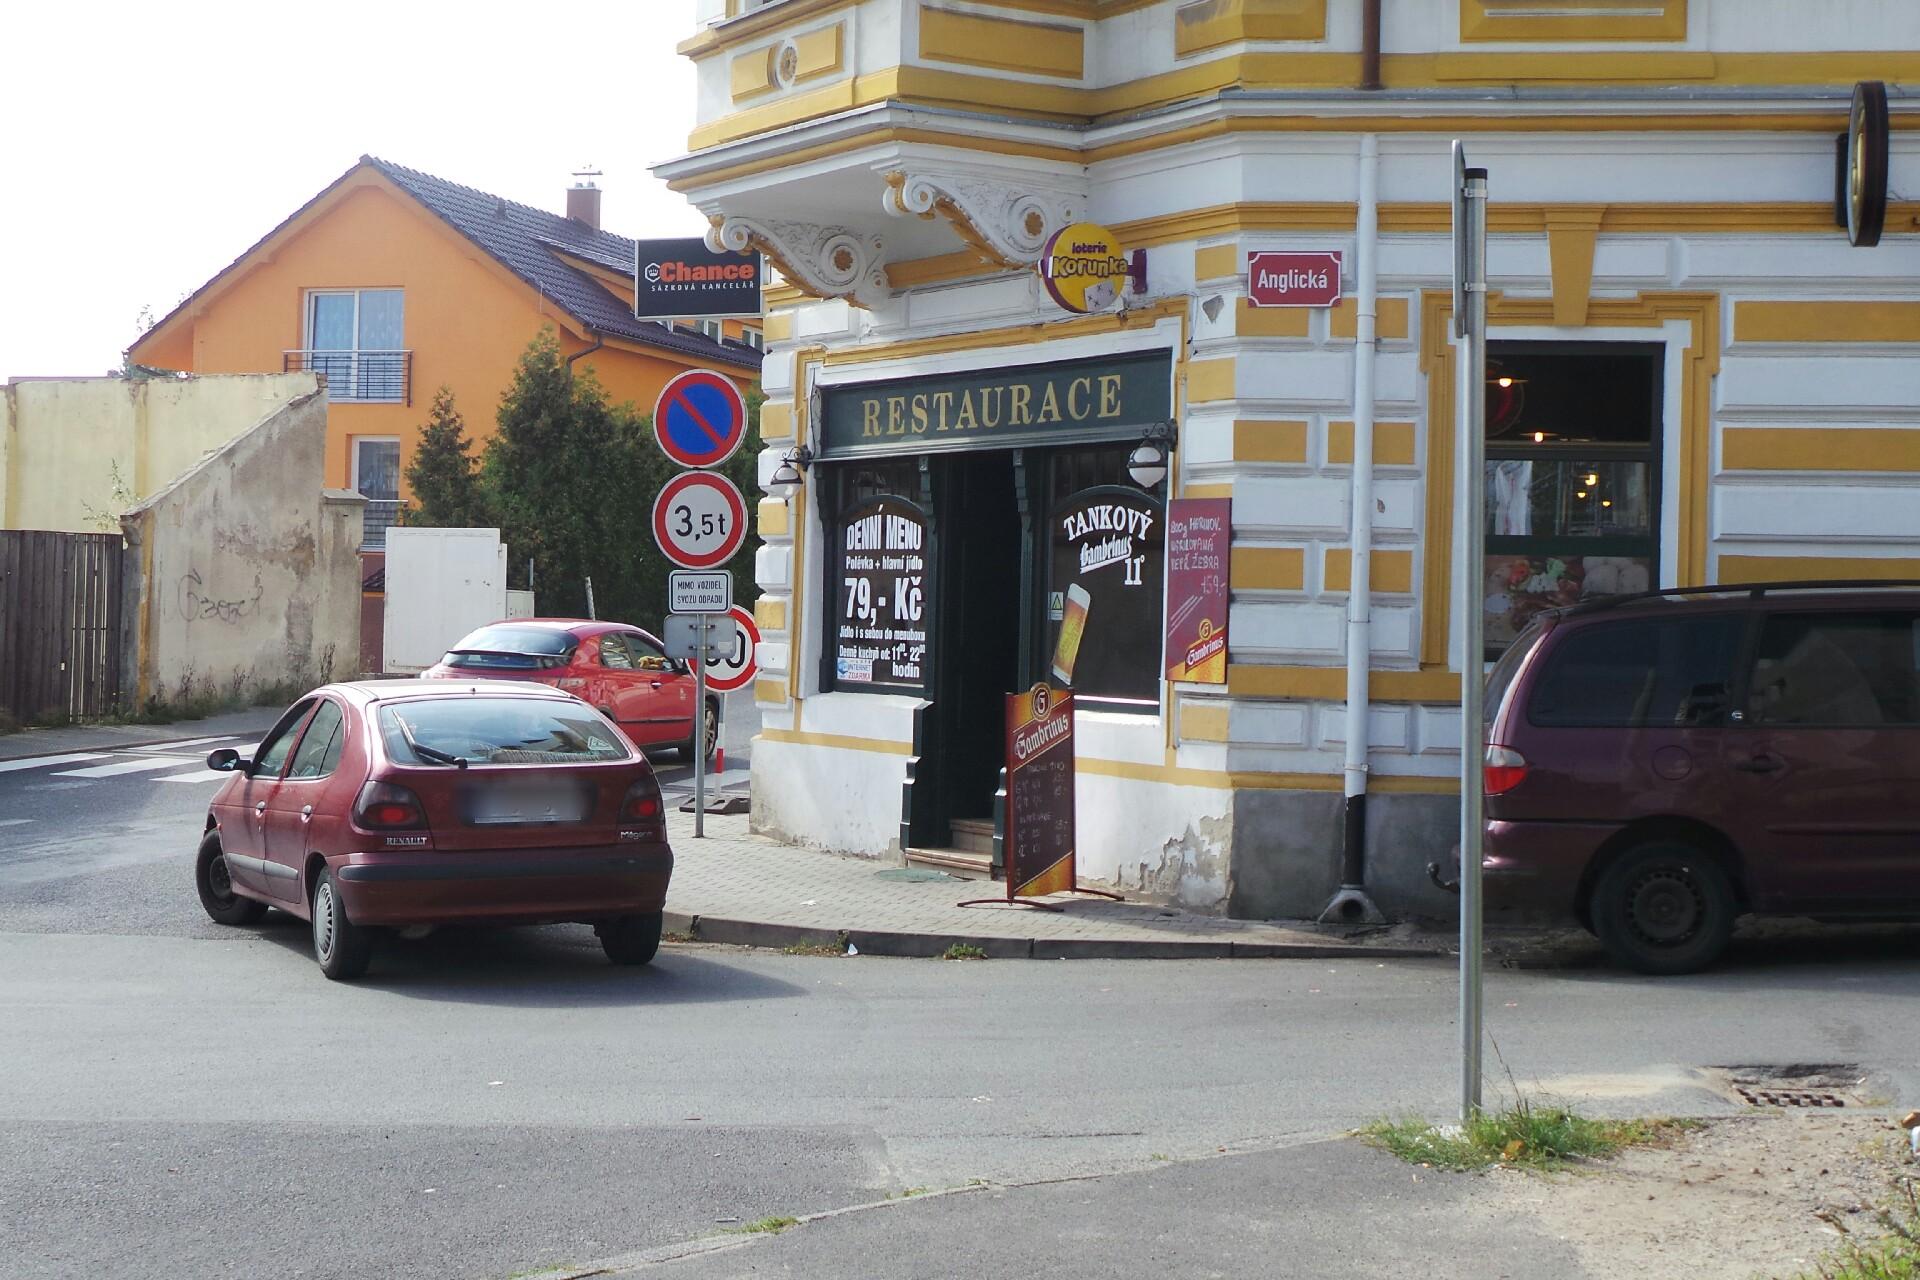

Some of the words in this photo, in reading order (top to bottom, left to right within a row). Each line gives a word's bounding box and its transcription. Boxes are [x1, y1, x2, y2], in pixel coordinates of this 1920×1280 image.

[1071, 241, 1107, 254] loterie
[660, 261, 755, 282] Chance
[1051, 255, 1128, 278] Korunka
[1257, 268, 1328, 293] Anglická
[861, 374, 1122, 437] RESTAURACE
[846, 503, 882, 550] DENNÍ
[885, 514, 922, 550] MENU
[1063, 504, 1154, 541] TANKOVÝ
[1080, 533, 1133, 568] Gambrinus
[846, 555, 874, 570] Polévka
[882, 555, 904, 570] hlavní
[905, 555, 923, 573] jídlo
[677, 581, 695, 590] MIMO
[697, 580, 723, 590] VOZIDEL
[698, 594, 723, 604] ODPADU
[894, 576, 922, 621] Kč
[1186, 636, 1224, 666] Gambrinus
[892, 661, 920, 678] hodin
[1014, 714, 1069, 760] Gambrinus
[386, 836, 428, 846] RENAULT
